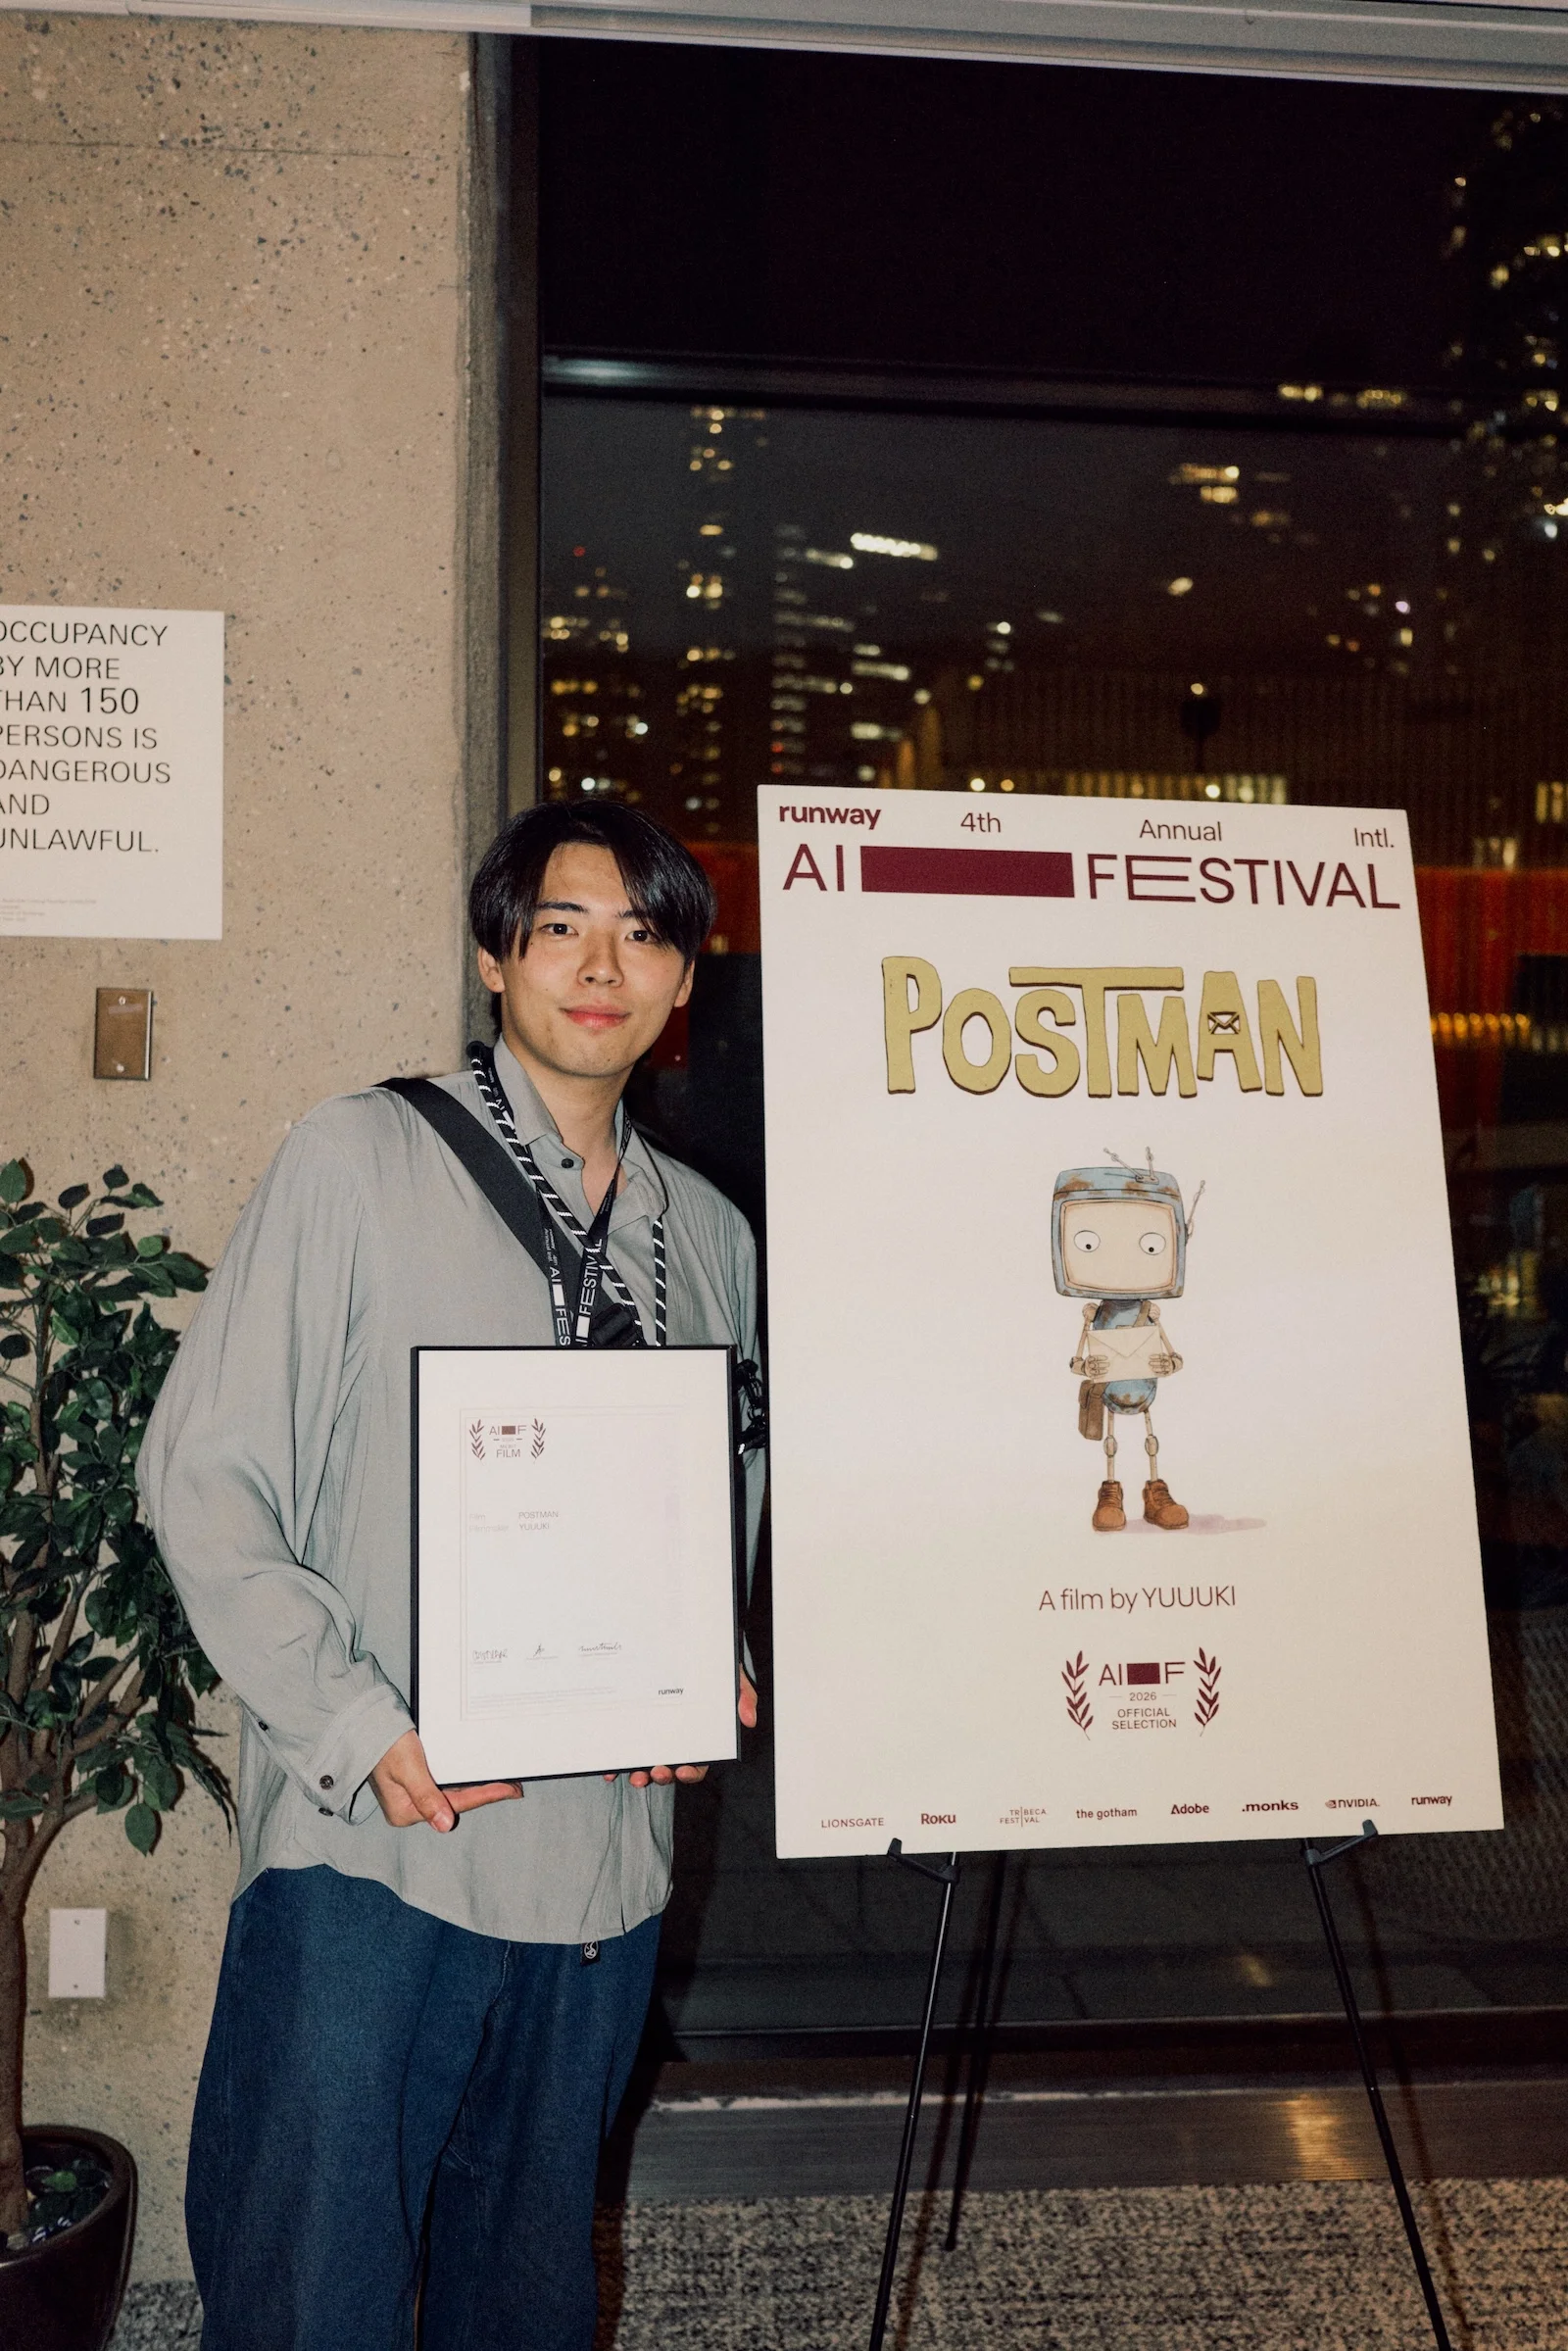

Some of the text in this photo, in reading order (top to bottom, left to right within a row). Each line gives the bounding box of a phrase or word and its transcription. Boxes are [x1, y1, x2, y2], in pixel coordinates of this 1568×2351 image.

[35, 656, 120, 679] MORE
[0, 687, 139, 714] HAN 150
[0, 724, 158, 750] ERSONS IS
[779, 805, 1396, 849] runway 4th Annual Intl.
[782, 843, 1401, 909] AI FESTIVAL
[881, 955, 1324, 1099] POSTMAN
[579, 1238, 603, 1315] FESTIVL
[550, 1267, 571, 1346] AI FES
[496, 1448, 521, 1458] FILM
[518, 1510, 559, 1519] POSTMAN
[1039, 1586, 1236, 1614] A film by YUUUKI
[1098, 1661, 1186, 1687] AI F
[658, 1687, 684, 1695] runway
[1129, 1691, 1157, 1702] 2026
[1117, 1707, 1171, 1718] OFFICIAL
[1111, 1718, 1178, 1731] SELECTION
[1242, 1799, 1299, 1812] .monks
[1411, 1794, 1452, 1808] runway
[1075, 1807, 1138, 1821] the gotham
[1170, 1803, 1210, 1815] Adobe
[820, 1817, 885, 1829] LIONSGATE
[920, 1813, 956, 1825] Roku
